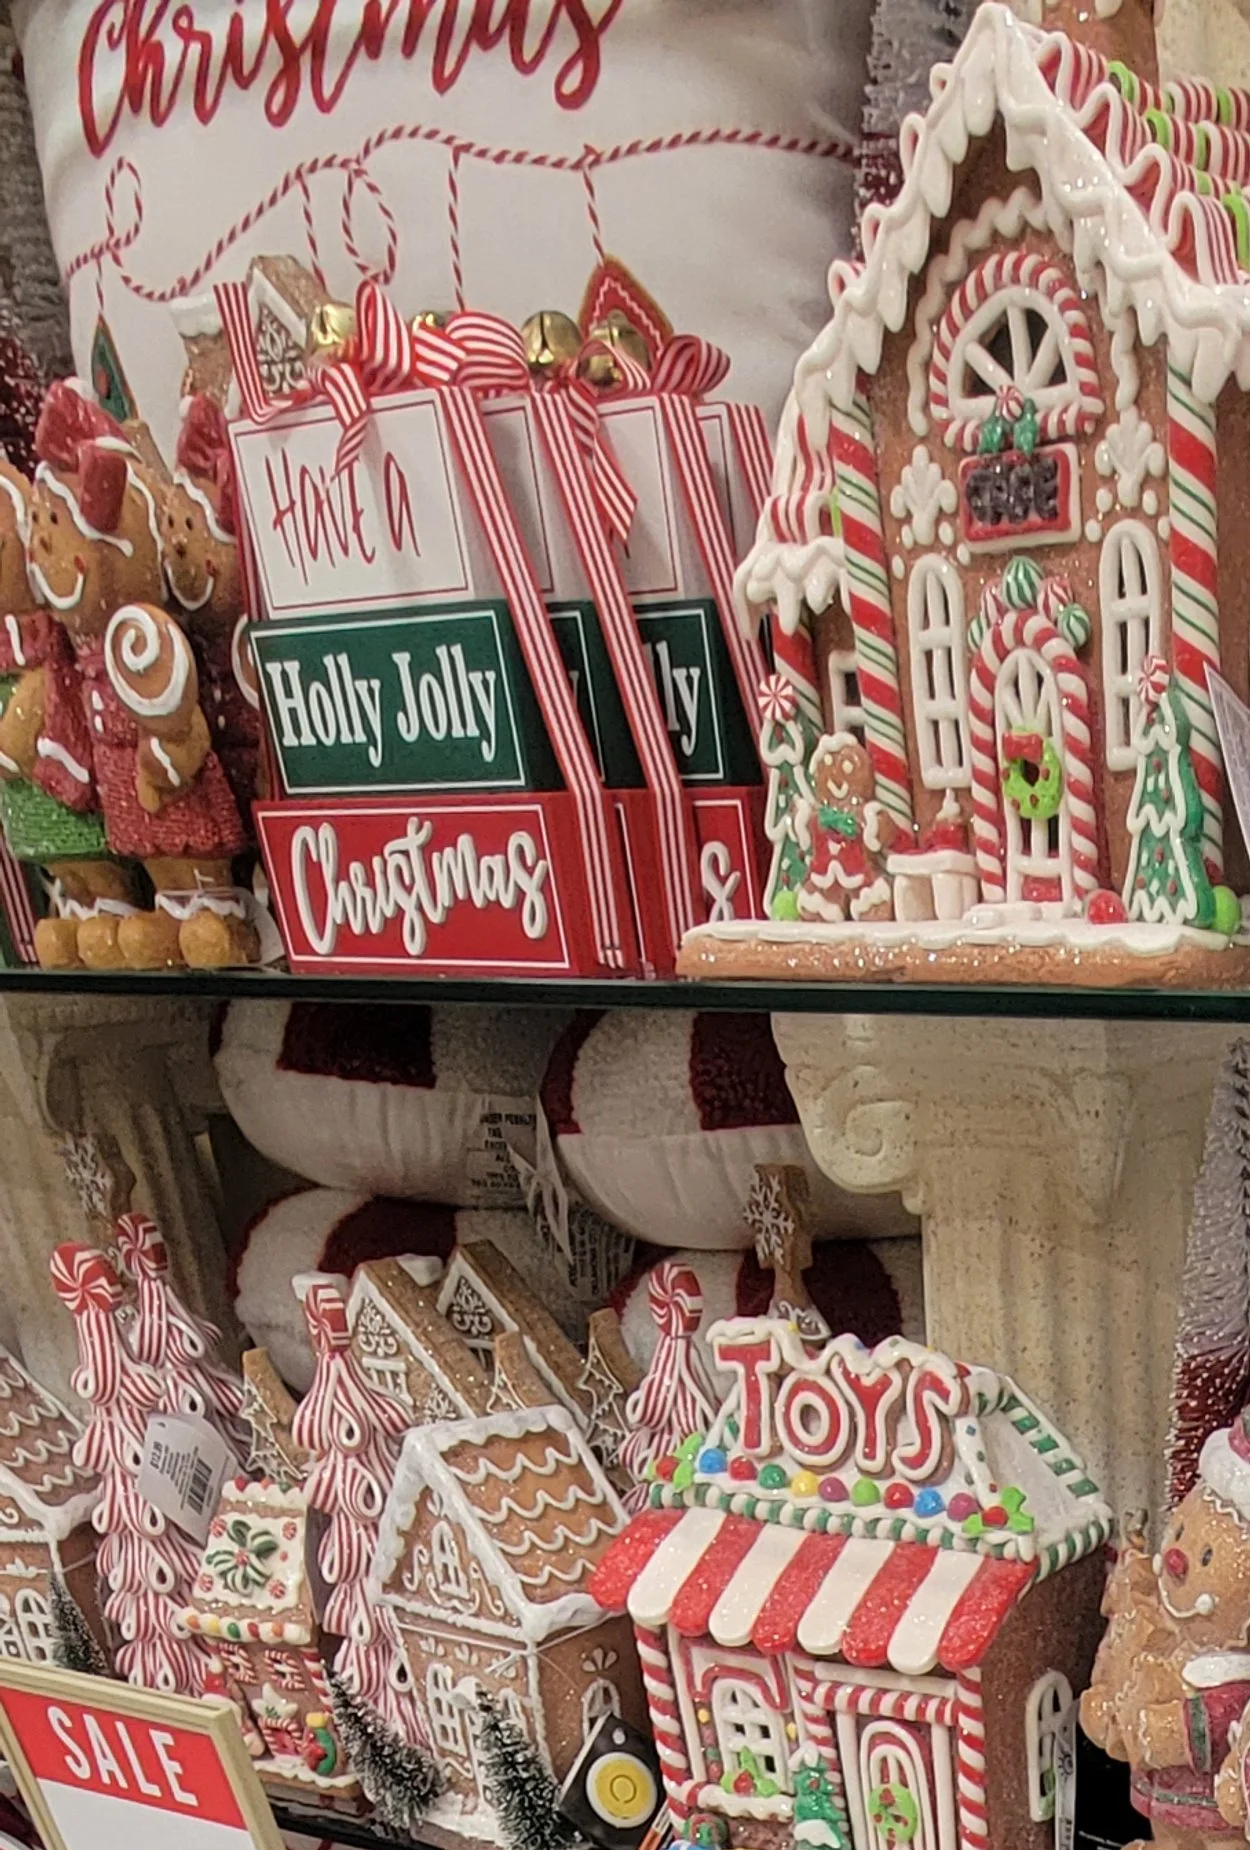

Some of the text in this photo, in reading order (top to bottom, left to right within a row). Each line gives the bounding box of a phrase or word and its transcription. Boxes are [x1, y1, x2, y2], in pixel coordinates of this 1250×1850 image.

[266, 643, 497, 768] Holly Jolly
[291, 817, 548, 957] Christmas
[713, 1335, 961, 1482] TOYS
[46, 1705, 198, 1808] SALE
